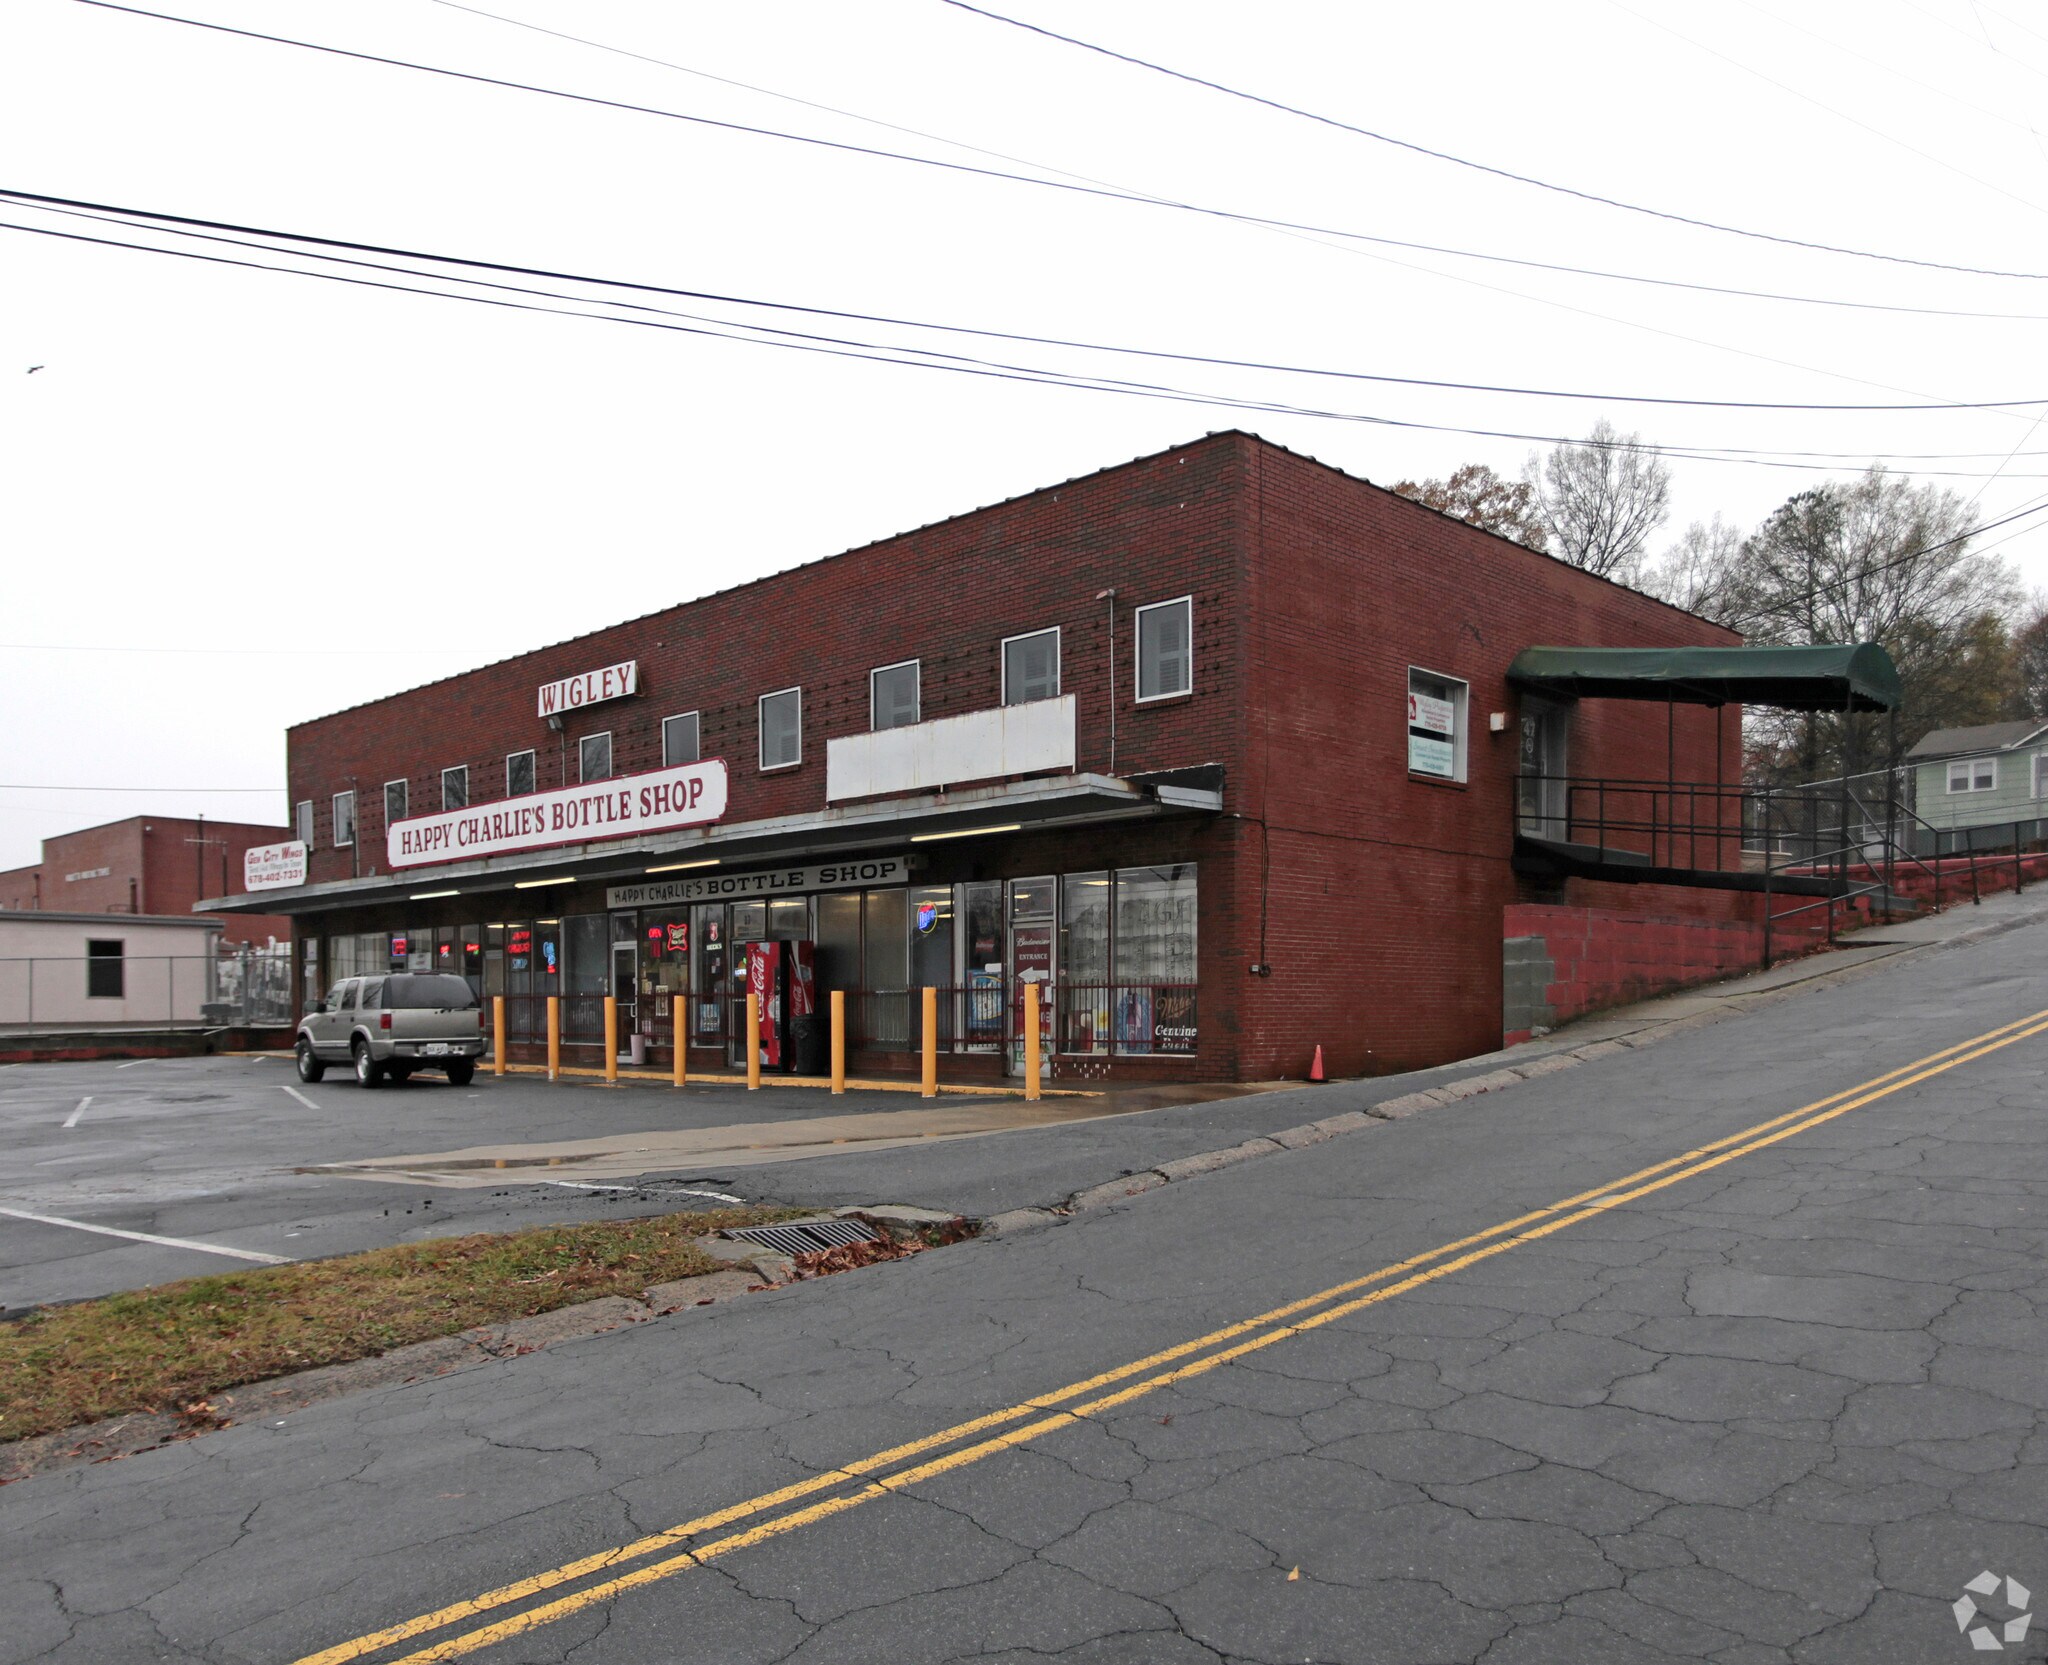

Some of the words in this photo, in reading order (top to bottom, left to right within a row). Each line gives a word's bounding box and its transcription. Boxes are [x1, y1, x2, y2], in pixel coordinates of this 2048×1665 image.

[542, 664, 630, 714] WIGLEY
[402, 822, 453, 855] HAPPY
[457, 803, 545, 846] CHARLIE'S
[552, 790, 632, 830] BOTTLE
[639, 777, 704, 817] SHOP
[248, 869, 303, 884] 678-402-7331
[614, 887, 645, 904] HAPPY
[648, 880, 703, 901] CHARLIE'S
[707, 871, 804, 895] BOTTLE
[819, 862, 897, 884] SHOP
[1019, 953, 1048, 961] ENTRANCE
[1155, 1024, 1198, 1037] Genuine
